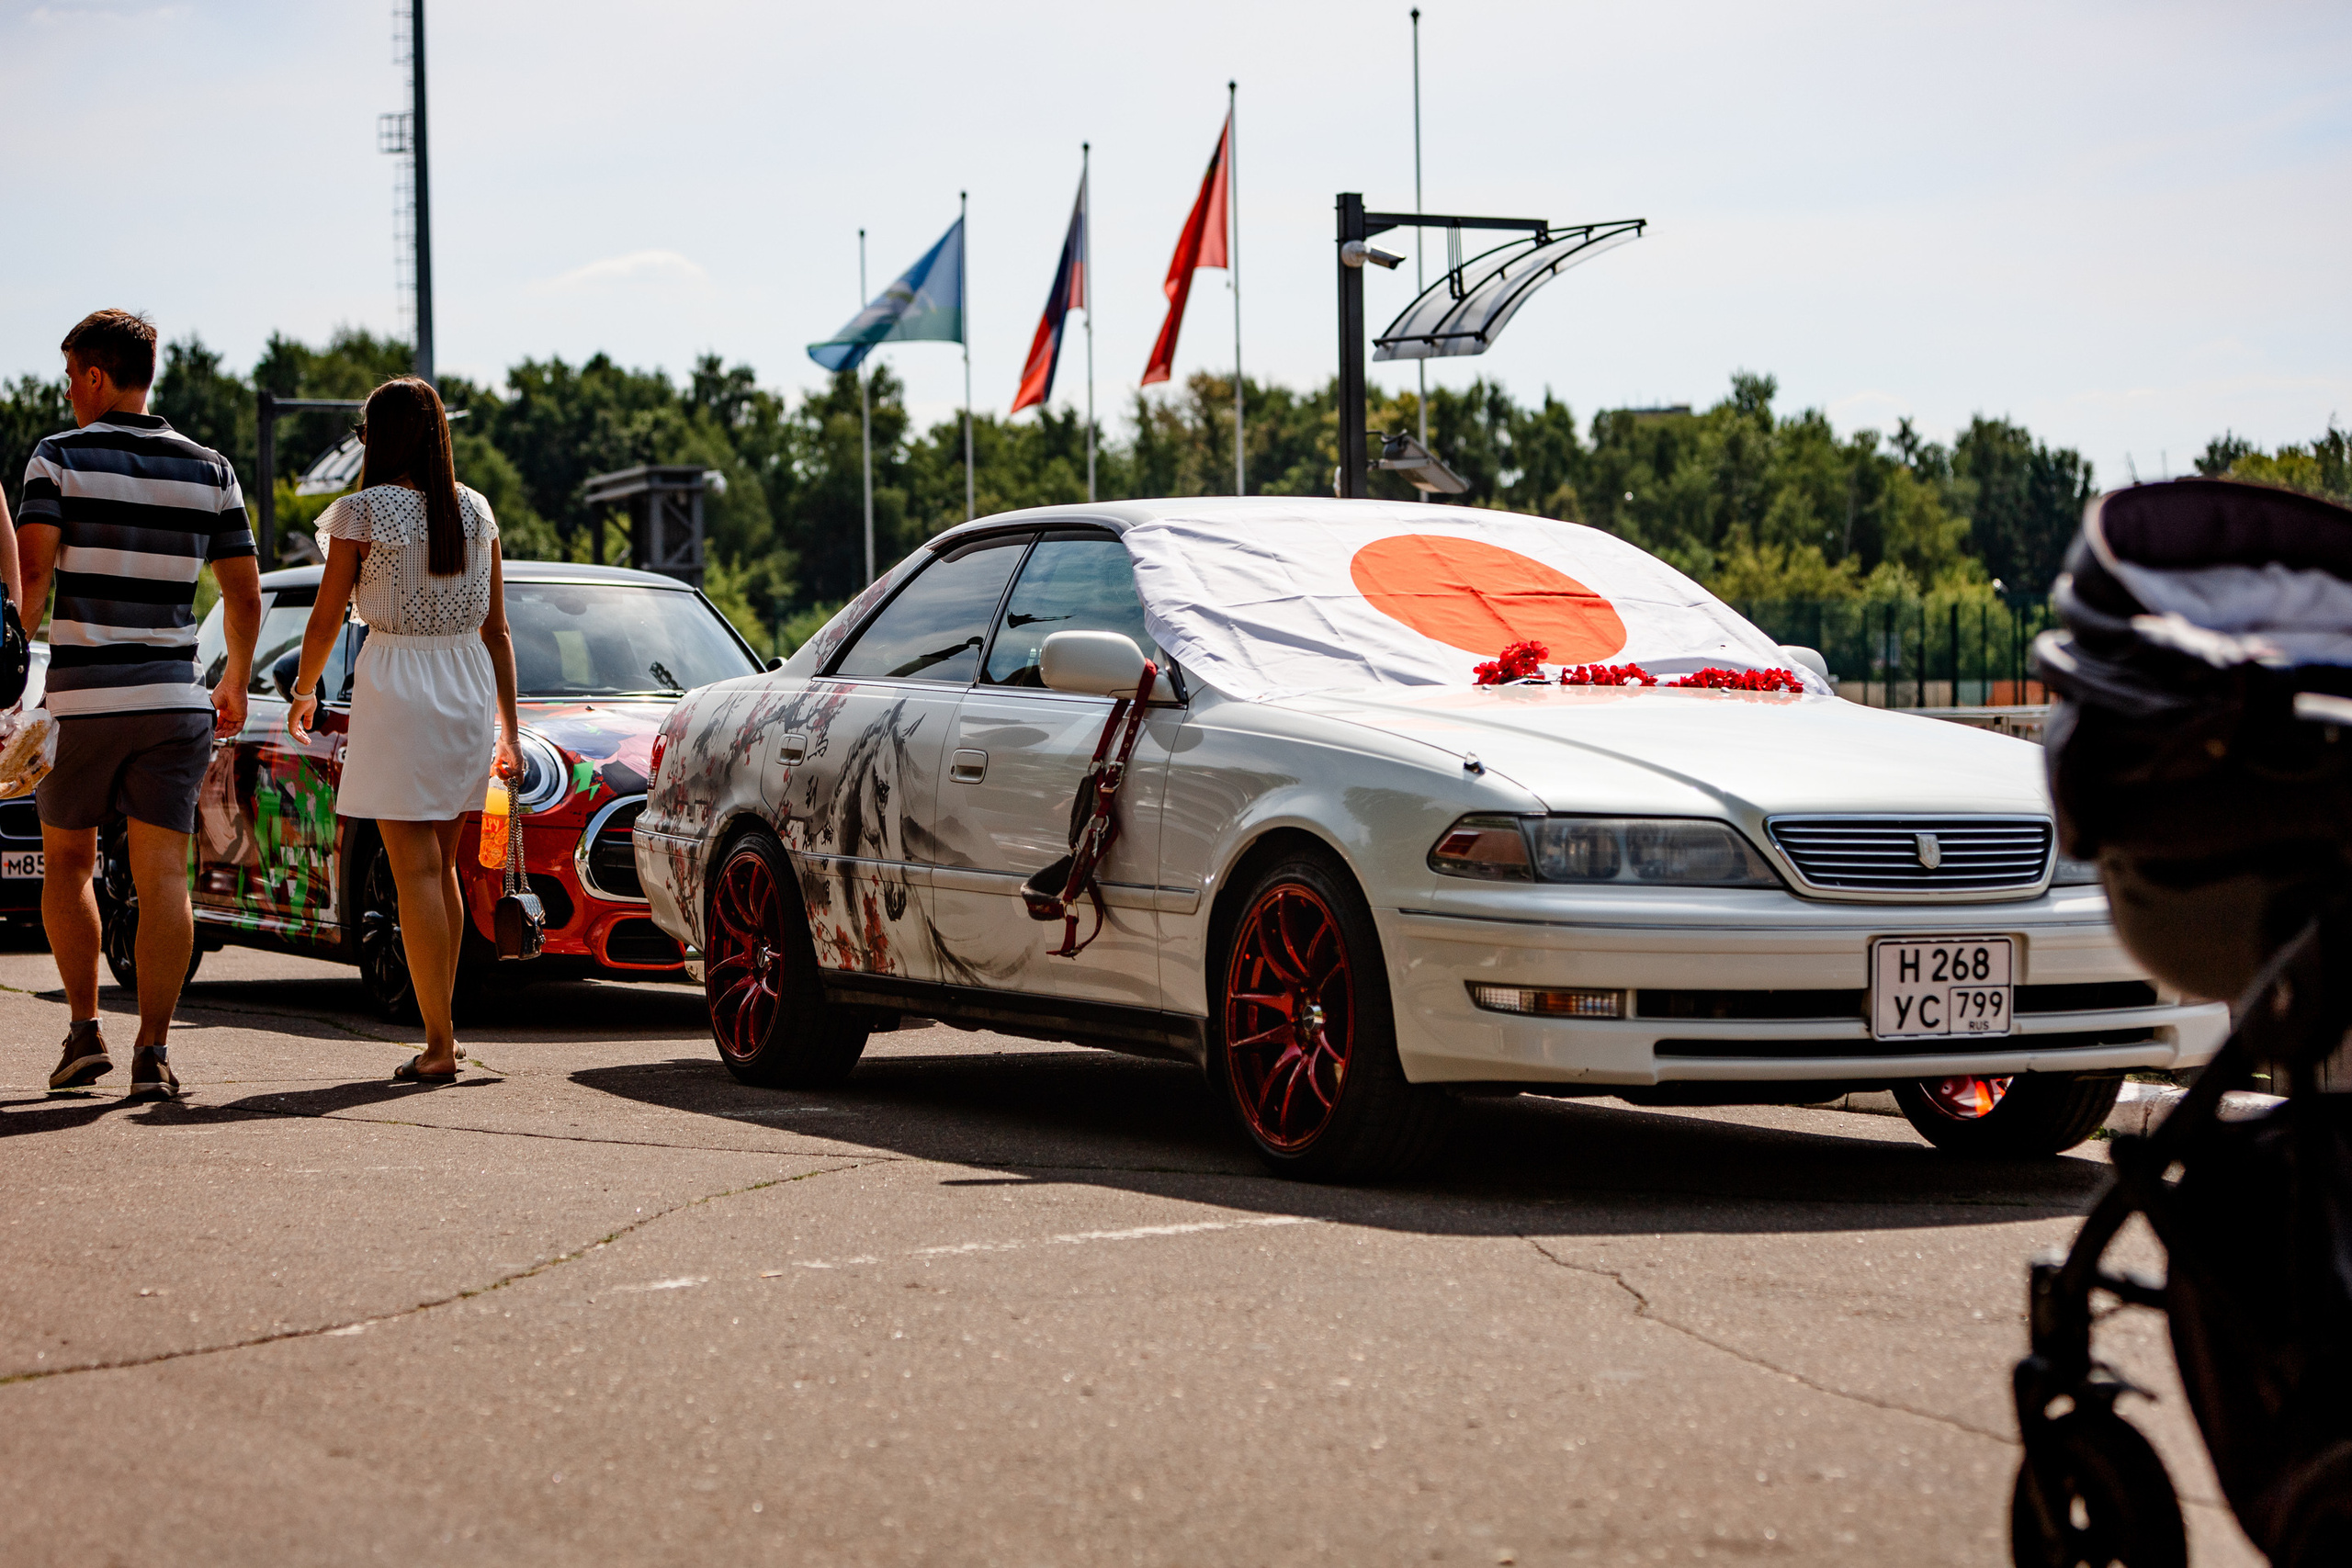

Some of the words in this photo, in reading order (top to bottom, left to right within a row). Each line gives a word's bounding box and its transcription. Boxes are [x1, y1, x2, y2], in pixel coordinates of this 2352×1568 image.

[482, 818, 500, 832] LPY
[1932, 947, 1990, 982] 268
[1956, 991, 2003, 1018] 799
[1968, 1021, 1989, 1031] RUS
